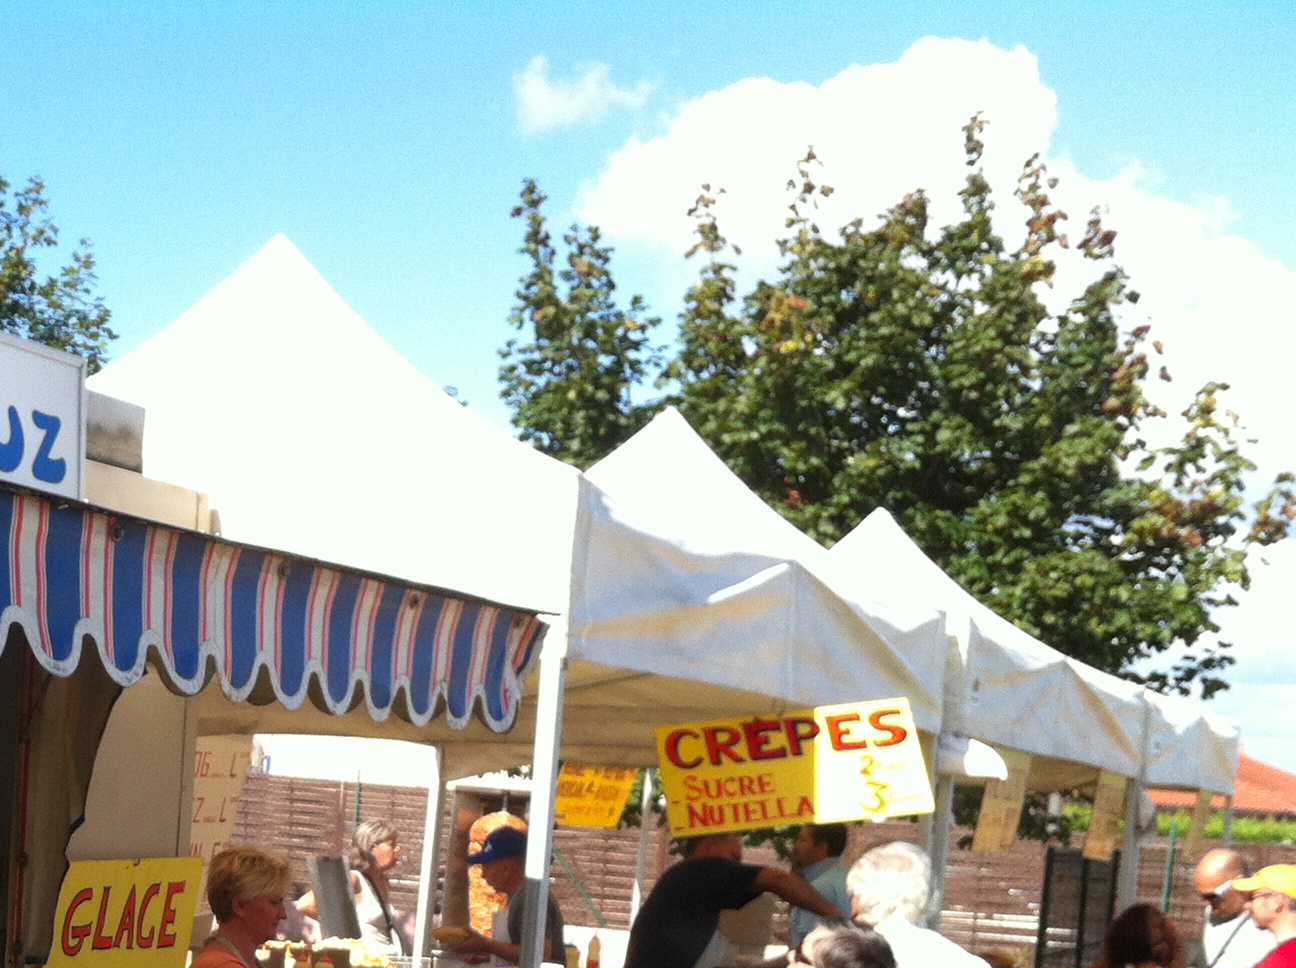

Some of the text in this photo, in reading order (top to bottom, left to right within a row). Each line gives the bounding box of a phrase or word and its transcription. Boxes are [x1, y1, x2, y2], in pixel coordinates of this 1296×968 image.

[683, 772, 777, 802] SUCRE
[687, 794, 817, 830] NUTELLA
[61, 880, 187, 957] GLACE
